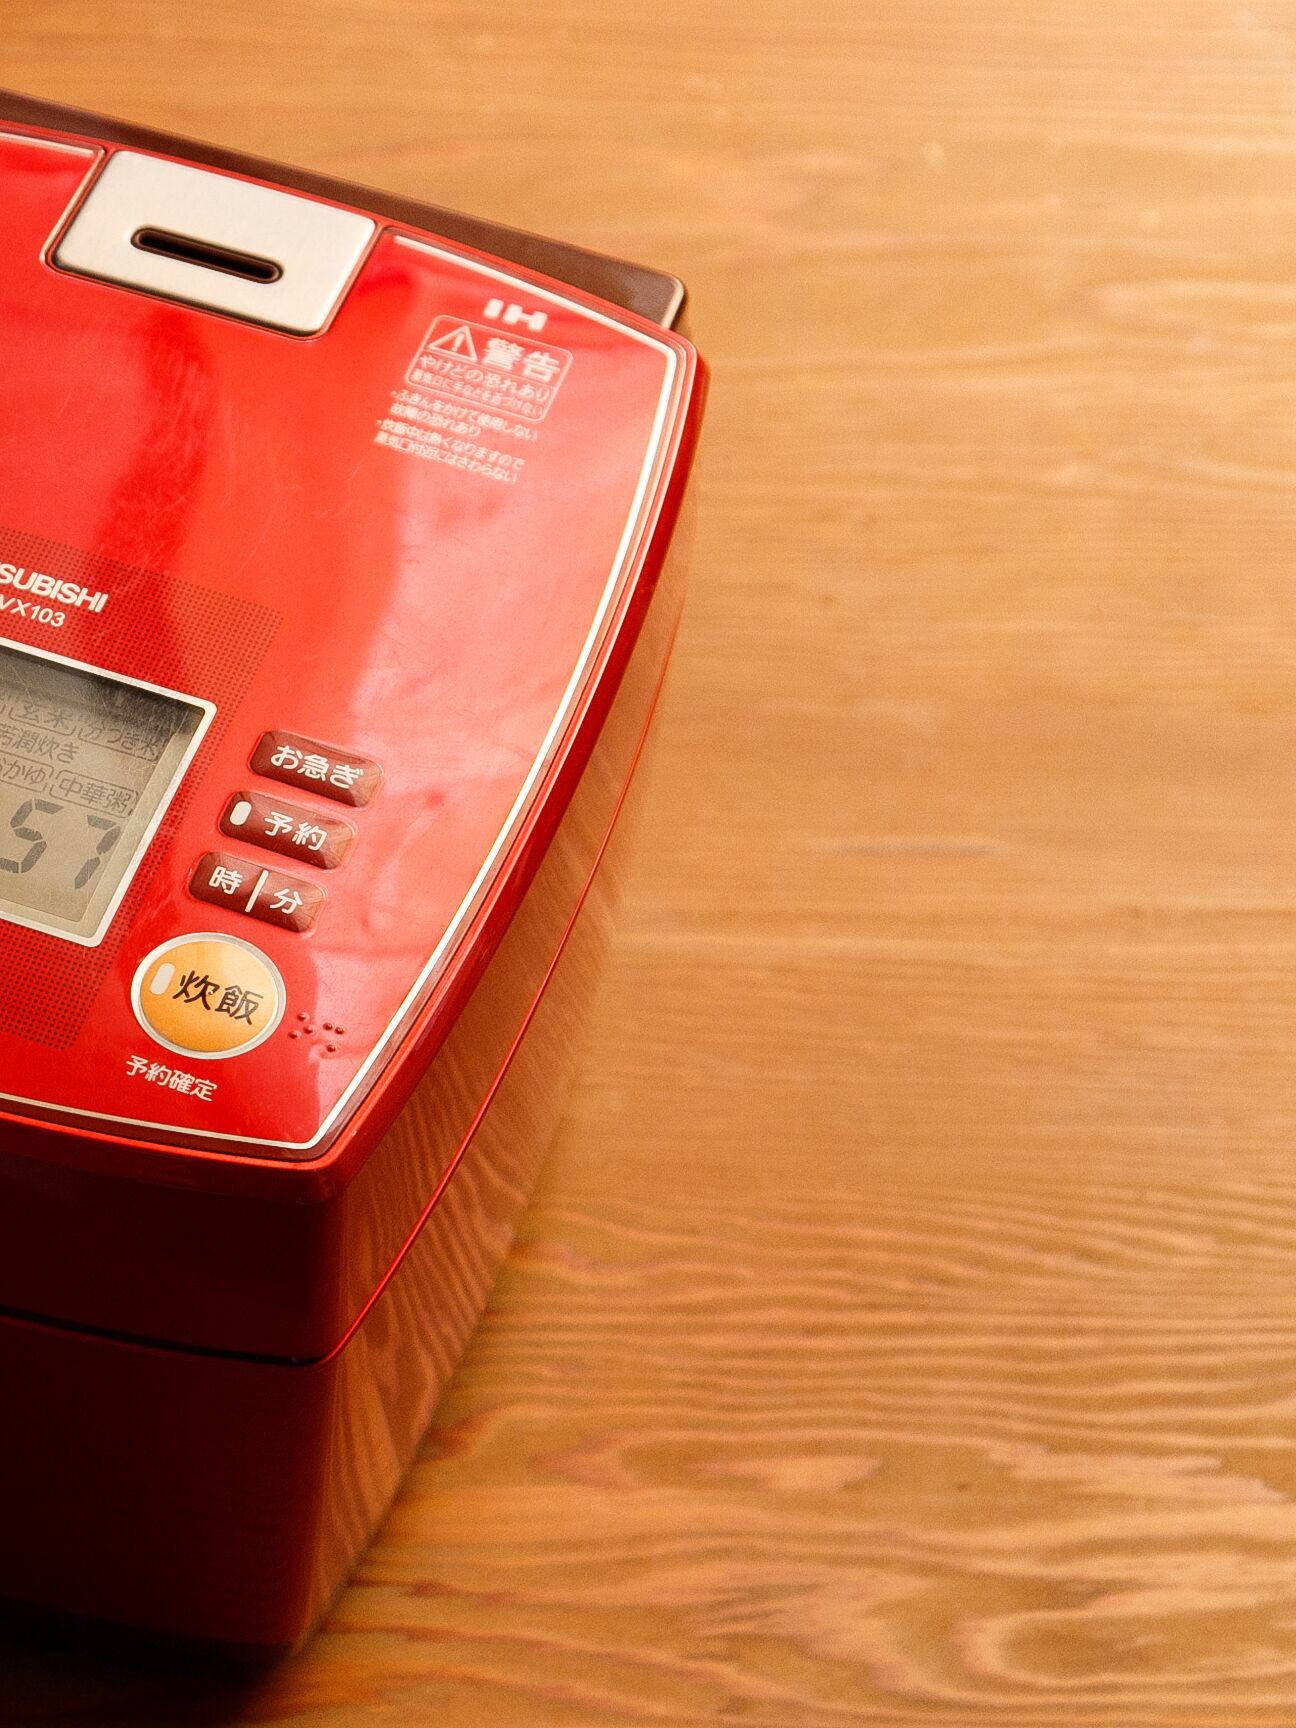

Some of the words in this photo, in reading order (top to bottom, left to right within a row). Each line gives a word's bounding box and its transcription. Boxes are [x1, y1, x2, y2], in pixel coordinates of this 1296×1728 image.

[484, 299, 548, 332] IH
[420, 354, 552, 402] やけどの恐れあり
[482, 337, 561, 383] 警告
[269, 744, 365, 790] お急ぎ
[58, 776, 133, 814] 中華粥
[263, 810, 329, 852] 予約
[208, 865, 241, 896] 時
[269, 887, 304, 916] 分
[172, 969, 265, 1026] 炊飯
[124, 1054, 219, 1102] 予約確定
